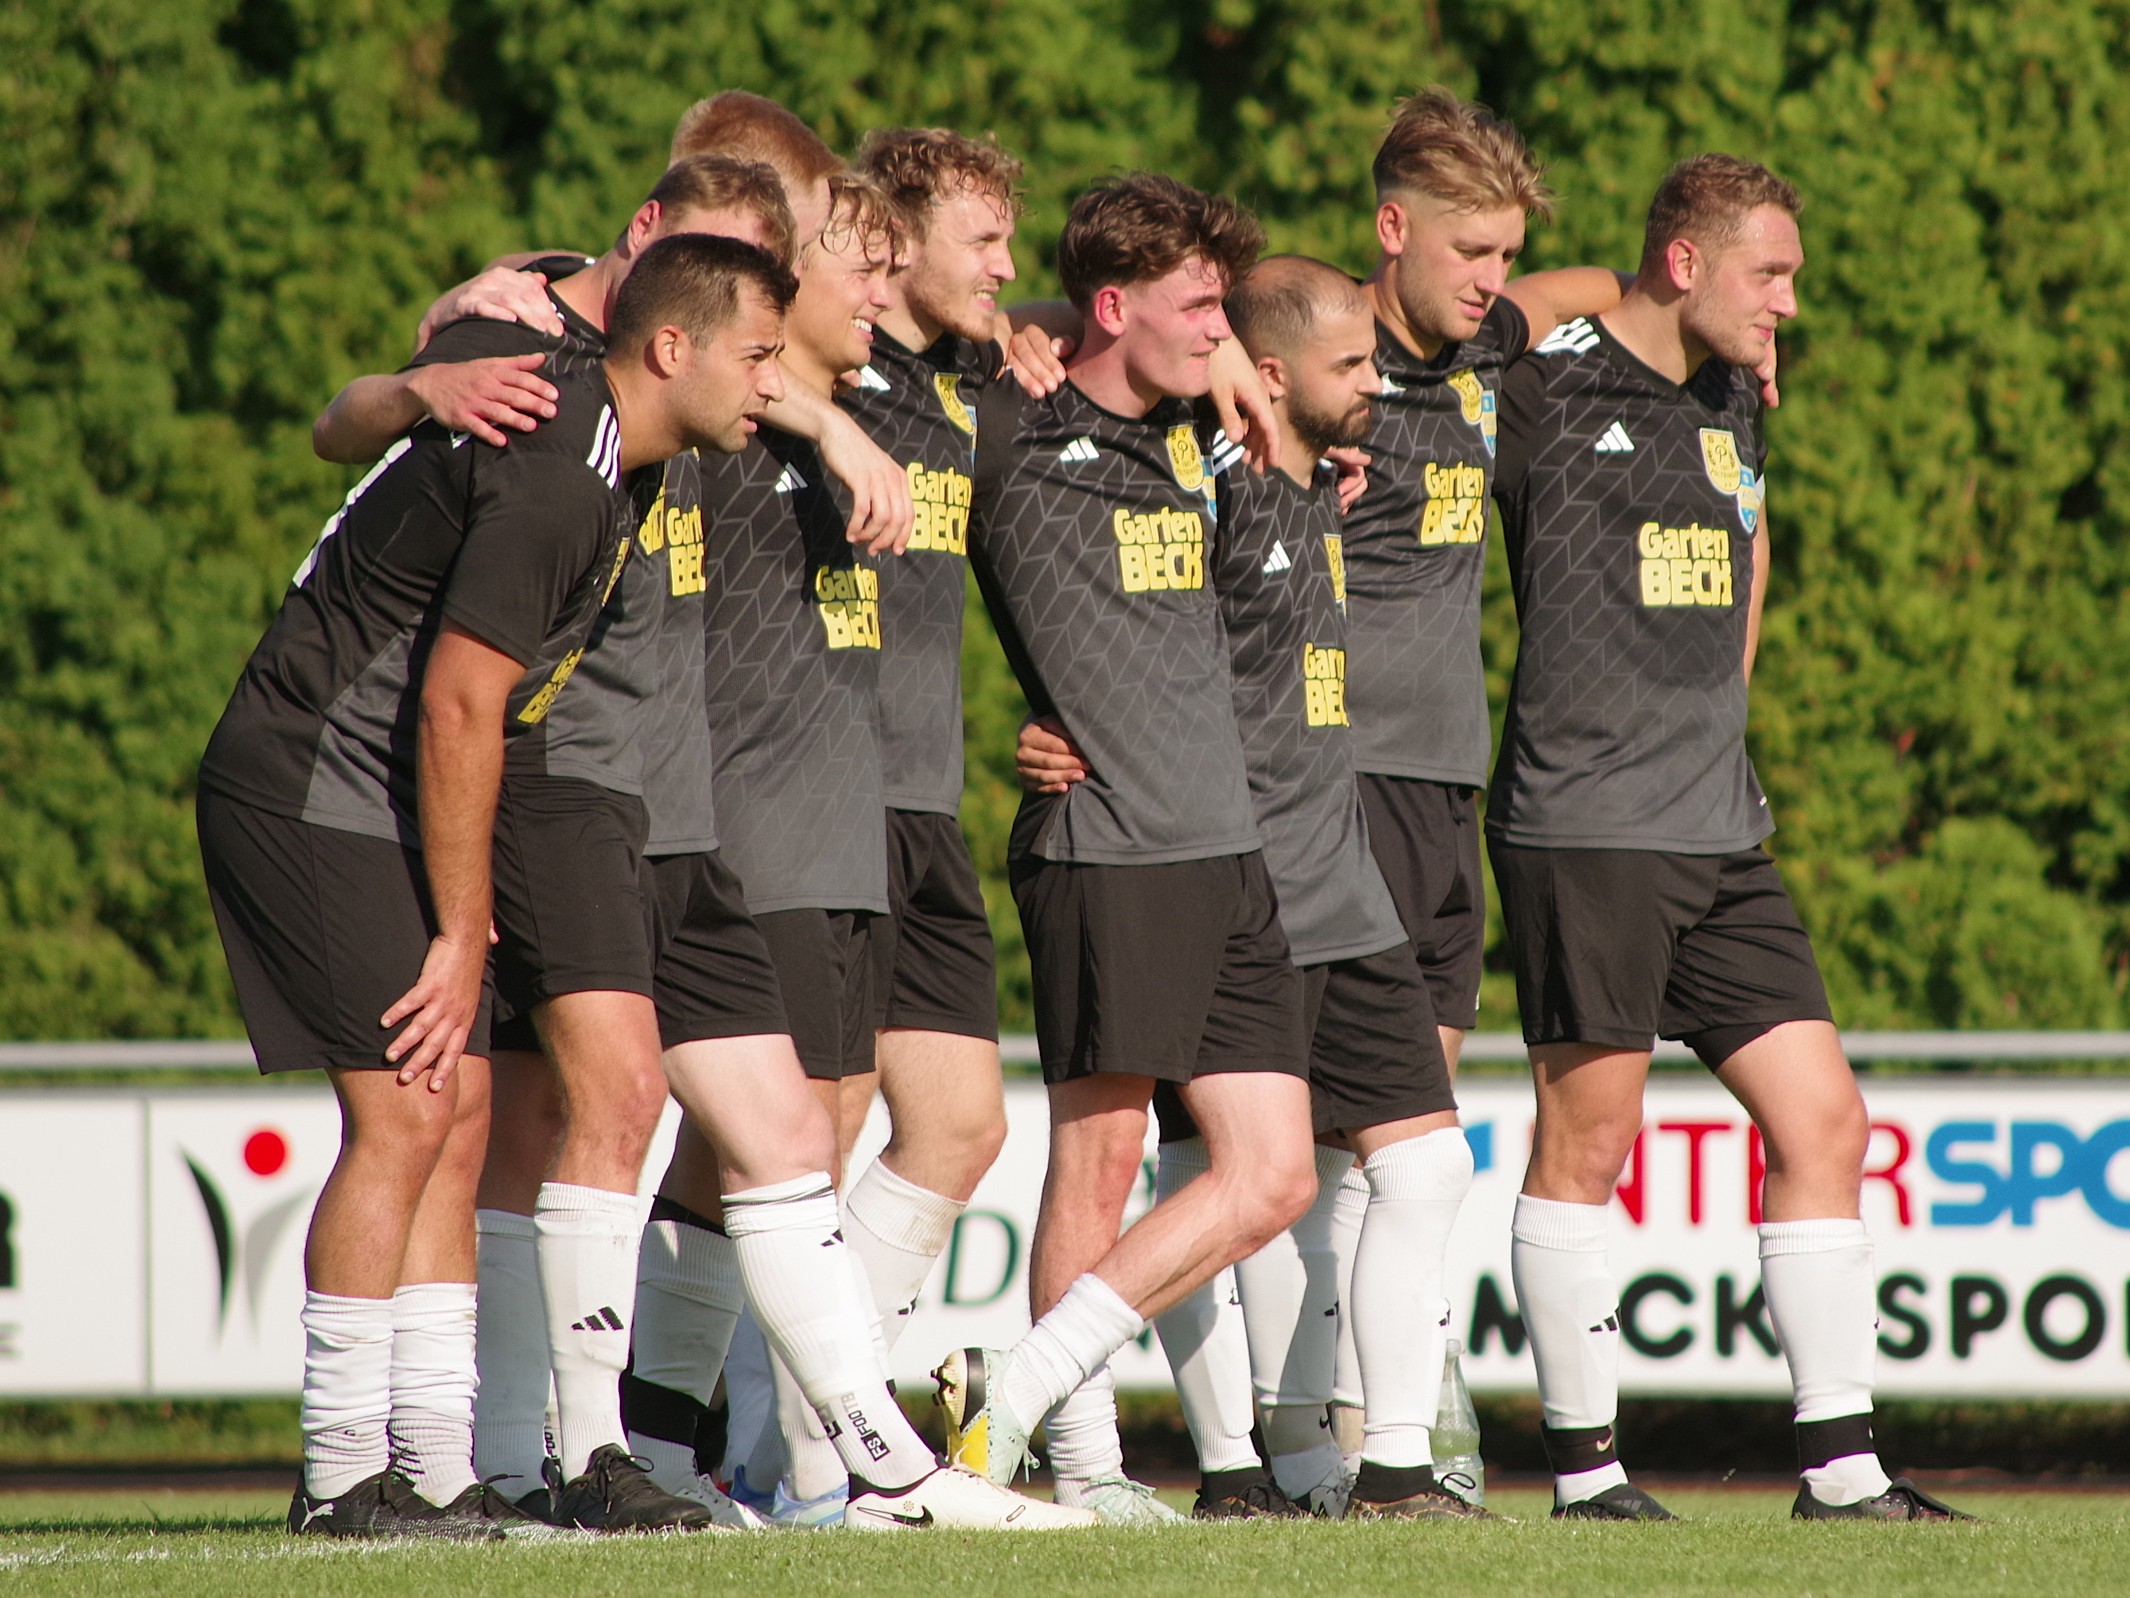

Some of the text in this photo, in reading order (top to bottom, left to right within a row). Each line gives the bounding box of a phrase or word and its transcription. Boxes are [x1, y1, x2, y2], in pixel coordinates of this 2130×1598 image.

[906, 462, 972, 507] Garten
[1423, 461, 1484, 499] Garten
[1114, 506, 1203, 544] Garten
[1420, 498, 1485, 545] BECK
[1639, 522, 1730, 559] Garten
[670, 543, 706, 596] BEC
[1119, 542, 1203, 592] BECK
[1641, 558, 1733, 606] BECK
[1468, 1272, 2130, 1362] MCK SPO
